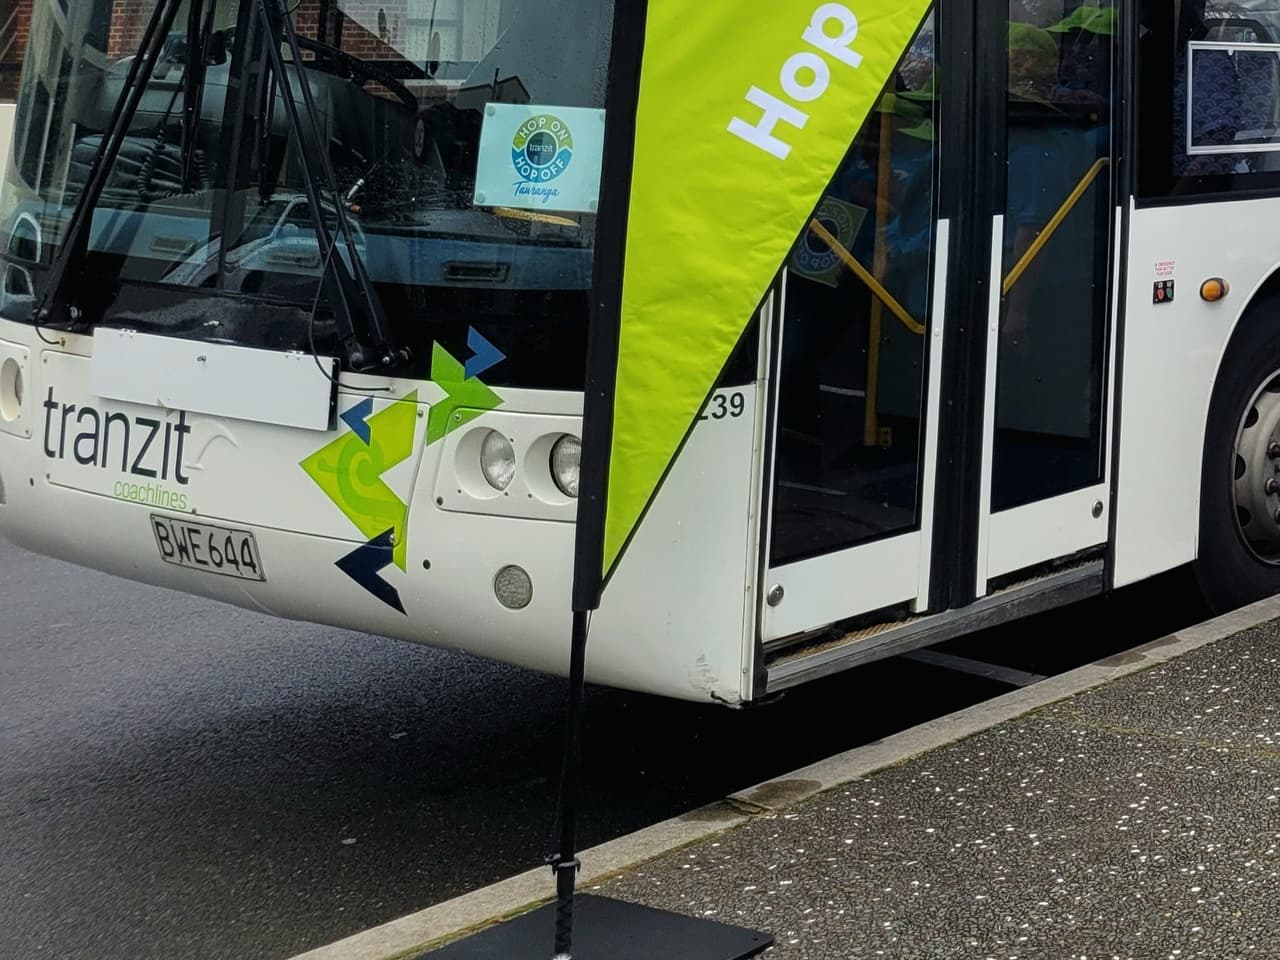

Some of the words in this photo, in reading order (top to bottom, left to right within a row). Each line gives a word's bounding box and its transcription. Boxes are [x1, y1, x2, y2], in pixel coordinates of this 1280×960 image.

[726, 2, 864, 161] Hop
[520, 117, 546, 138] HOP
[551, 121, 569, 141] ON
[515, 155, 538, 180] HOP
[540, 157, 565, 179] OFF
[512, 180, 560, 204] Tauranga
[698, 392, 745, 420] 39
[43, 386, 191, 485] tranzit
[113, 480, 188, 510] coachlines
[154, 521, 258, 574] BWE644
